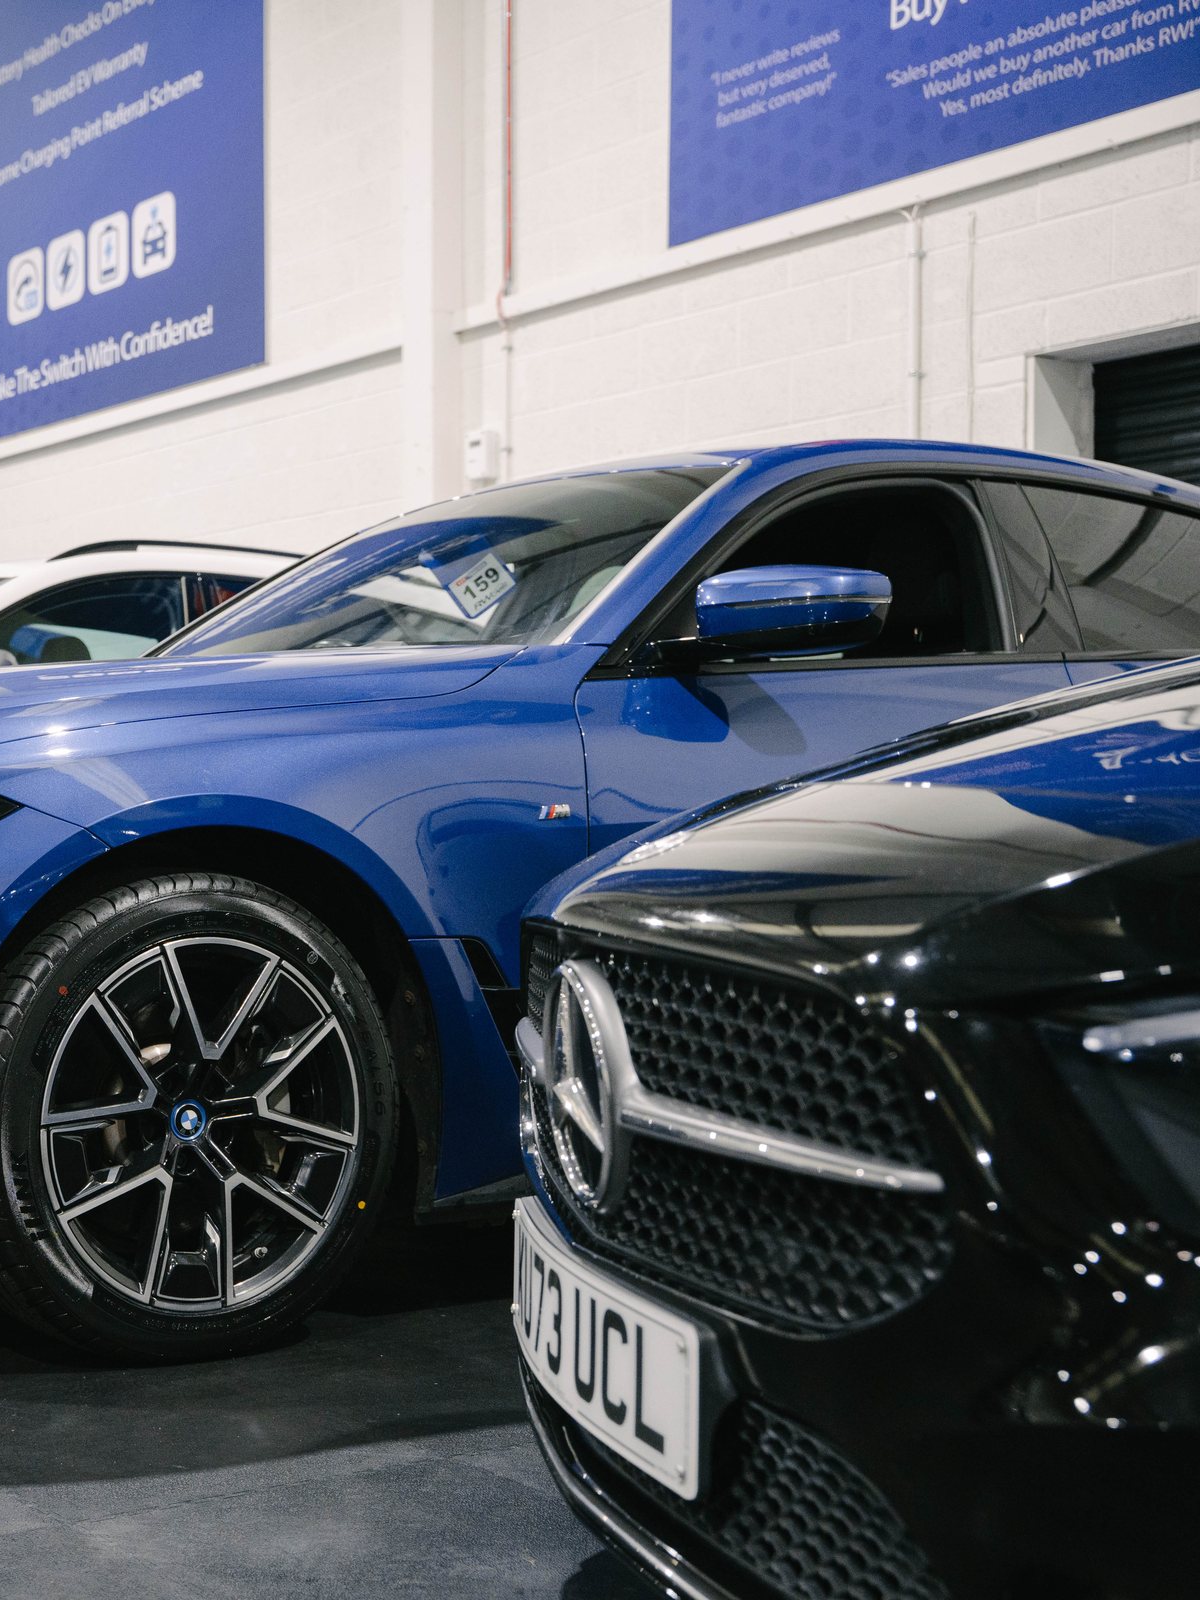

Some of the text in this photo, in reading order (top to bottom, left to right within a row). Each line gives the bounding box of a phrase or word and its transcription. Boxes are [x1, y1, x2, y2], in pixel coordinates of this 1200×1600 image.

[61, 11, 102, 48] Checks
[101, 1, 122, 24] On
[720, 60, 757, 84] never
[790, 28, 841, 58] reviews
[922, 67, 972, 99] Would
[973, 63, 998, 83] we
[999, 51, 1031, 74] buy
[1032, 28, 1099, 63] another
[1101, 18, 1129, 40] car
[1131, 2, 1174, 30] from
[929, 42, 983, 78] people
[984, 37, 1005, 55] an
[1007, 12, 1078, 47] absolute
[970, 82, 1010, 109] most
[1093, 35, 1155, 68] Thanks
[20, 135, 71, 174] Charging
[71, 117, 103, 150] Point
[102, 90, 149, 134] Referral
[150, 70, 204, 111] Scheme
[716, 99, 769, 128] fantastic
[15, 365, 42, 393] The
[41, 347, 86, 387] Switch
[84, 336, 121, 372] With
[120, 303, 214, 361] Confidence!
[463, 567, 500, 599] 159
[517, 1223, 665, 1456] KU73 UCL
